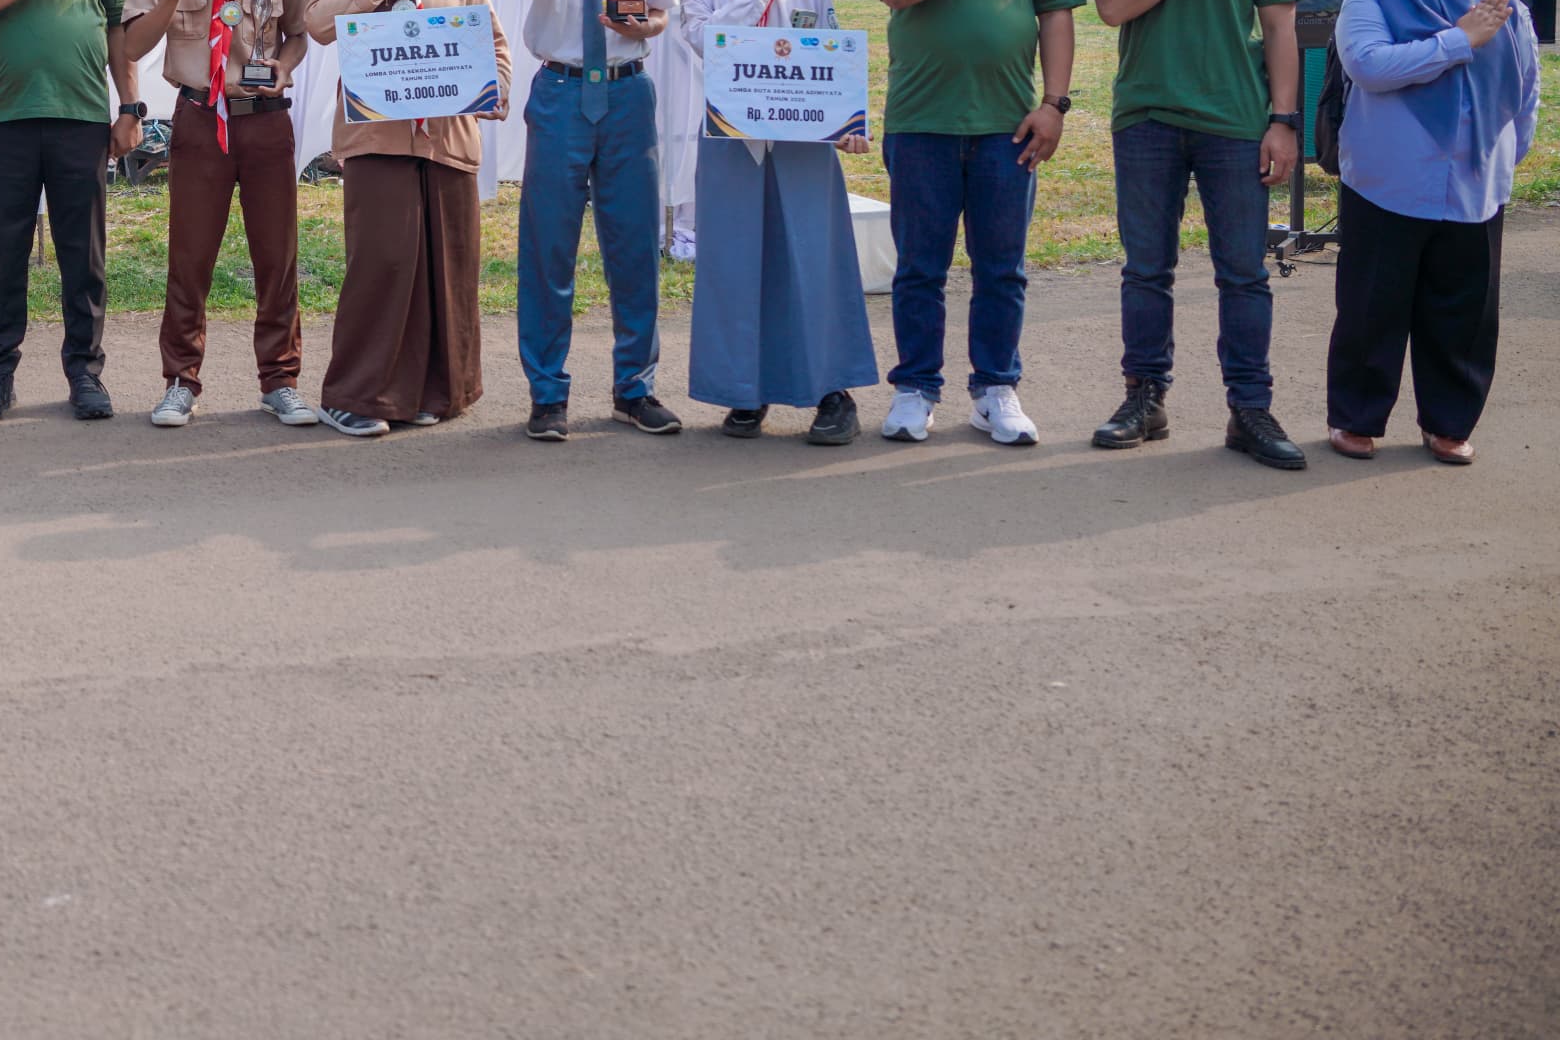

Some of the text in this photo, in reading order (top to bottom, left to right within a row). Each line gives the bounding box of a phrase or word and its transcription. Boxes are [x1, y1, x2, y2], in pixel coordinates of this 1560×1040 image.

[370, 42, 459, 67] JUARA II
[732, 63, 834, 82] JUARA III
[384, 84, 459, 103] Rp. 3.000.000
[747, 107, 824, 122] Rp. 2.000.000
